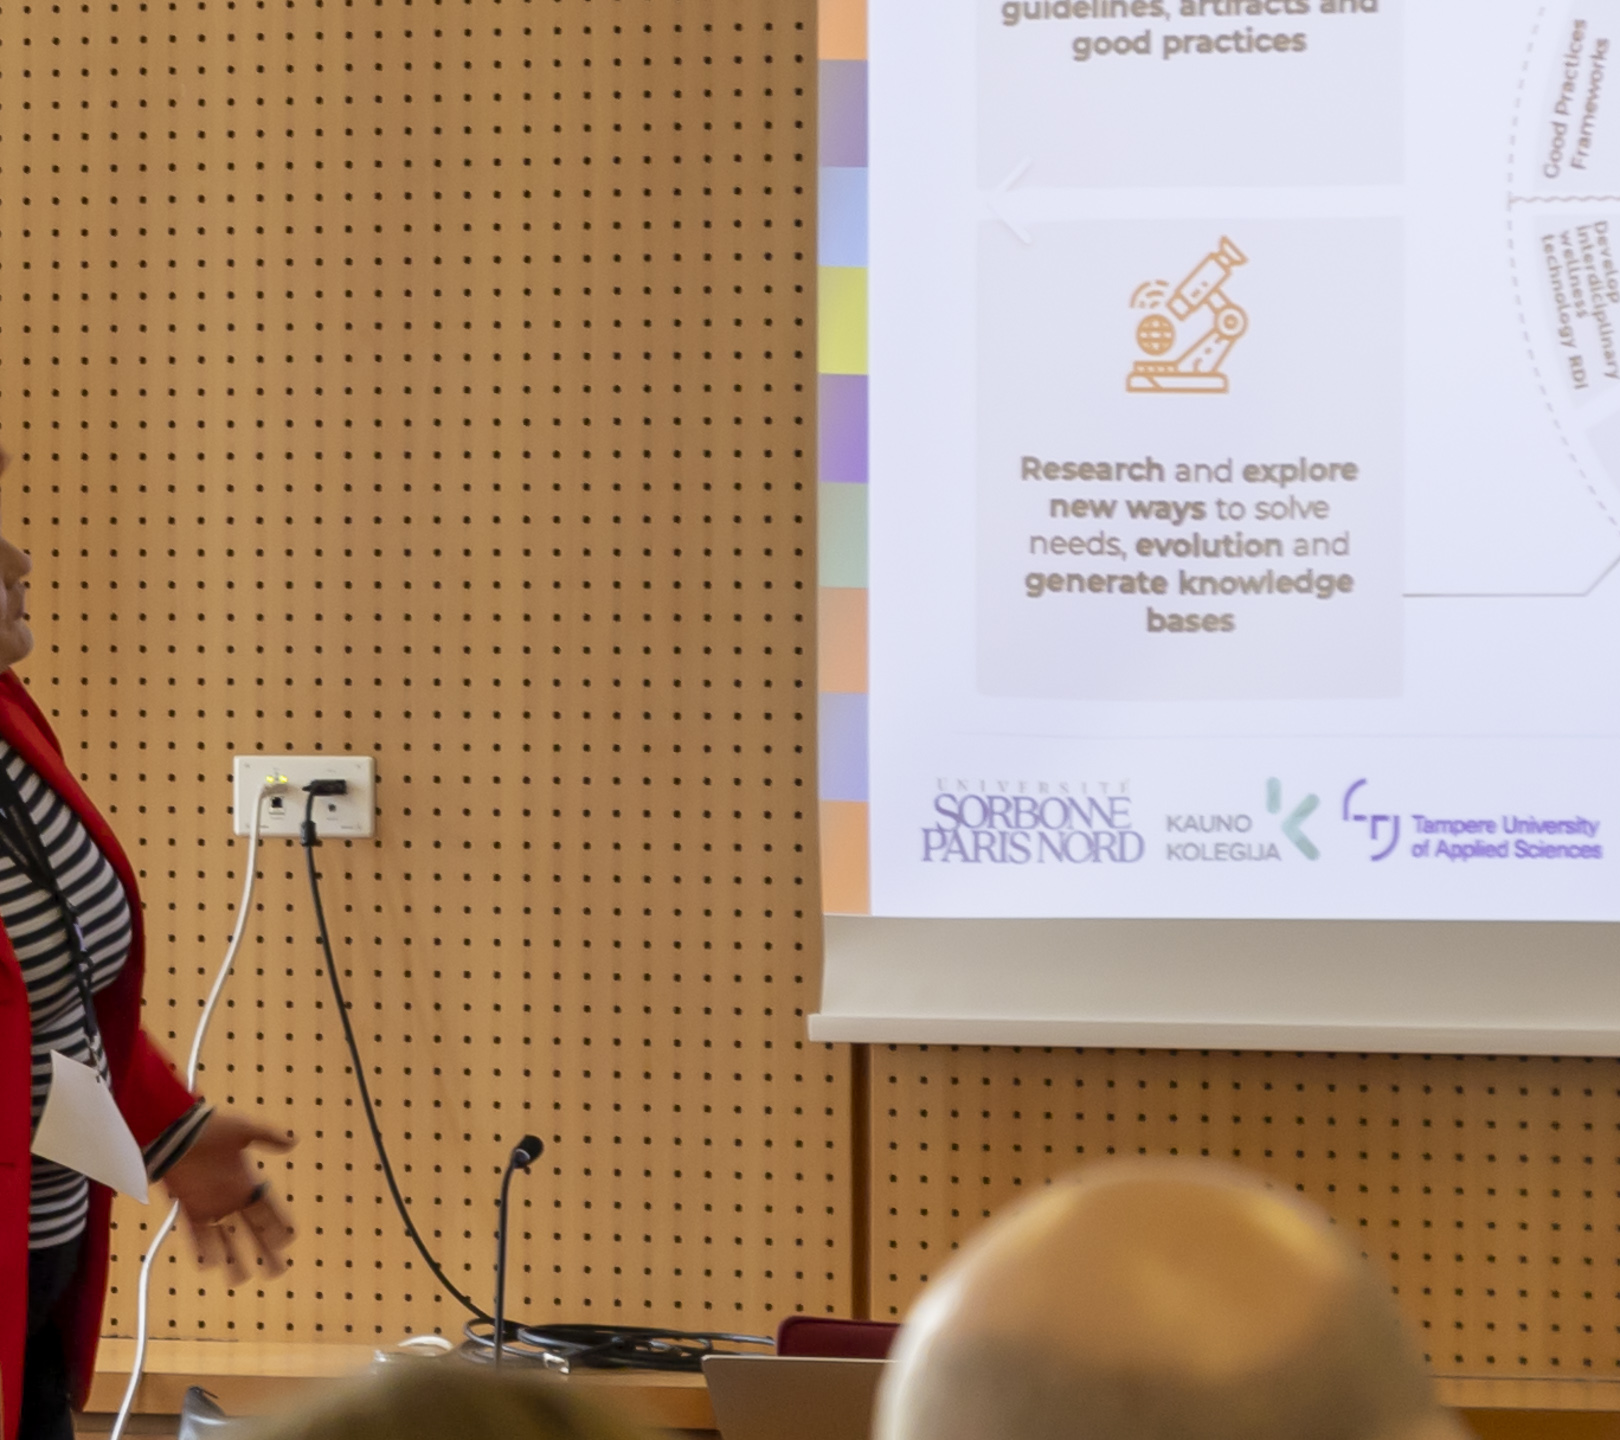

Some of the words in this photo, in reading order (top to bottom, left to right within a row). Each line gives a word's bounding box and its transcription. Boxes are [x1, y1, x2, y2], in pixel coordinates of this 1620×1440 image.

[1072, 29, 1151, 62] good
[1163, 27, 1307, 60] practices
[1554, 19, 1588, 116] Practices
[1570, 38, 1610, 170] Frameworks
[1543, 121, 1568, 179] Good
[1560, 231, 1588, 318] wellness
[1594, 220, 1620, 303] Develop
[1541, 234, 1576, 348] technology
[1568, 355, 1589, 389] RDI
[1021, 456, 1164, 482] Research
[1174, 458, 1233, 483] and
[1242, 457, 1358, 488] explore
[1050, 497, 1117, 519] new
[1126, 497, 1207, 526] ways
[1216, 498, 1246, 521] to
[1255, 495, 1330, 521] solve
[1029, 532, 1127, 561] needs,
[1135, 532, 1282, 558] evolution
[1293, 532, 1350, 556] and
[1024, 571, 1168, 598] generate
[1178, 568, 1354, 599] knowledge
[1147, 607, 1236, 634] bases
[934, 793, 1133, 831] SORBONNE
[1166, 814, 1253, 834] KAUNO
[1411, 815, 1497, 836] Tampere
[1502, 815, 1600, 837] University
[921, 826, 1032, 864] PARIS
[1037, 830, 1146, 864] NORD
[1166, 842, 1282, 861] KOLEGIJA
[1411, 839, 1430, 858] of
[1435, 839, 1509, 861] Applied
[1514, 839, 1604, 859] Sciences
